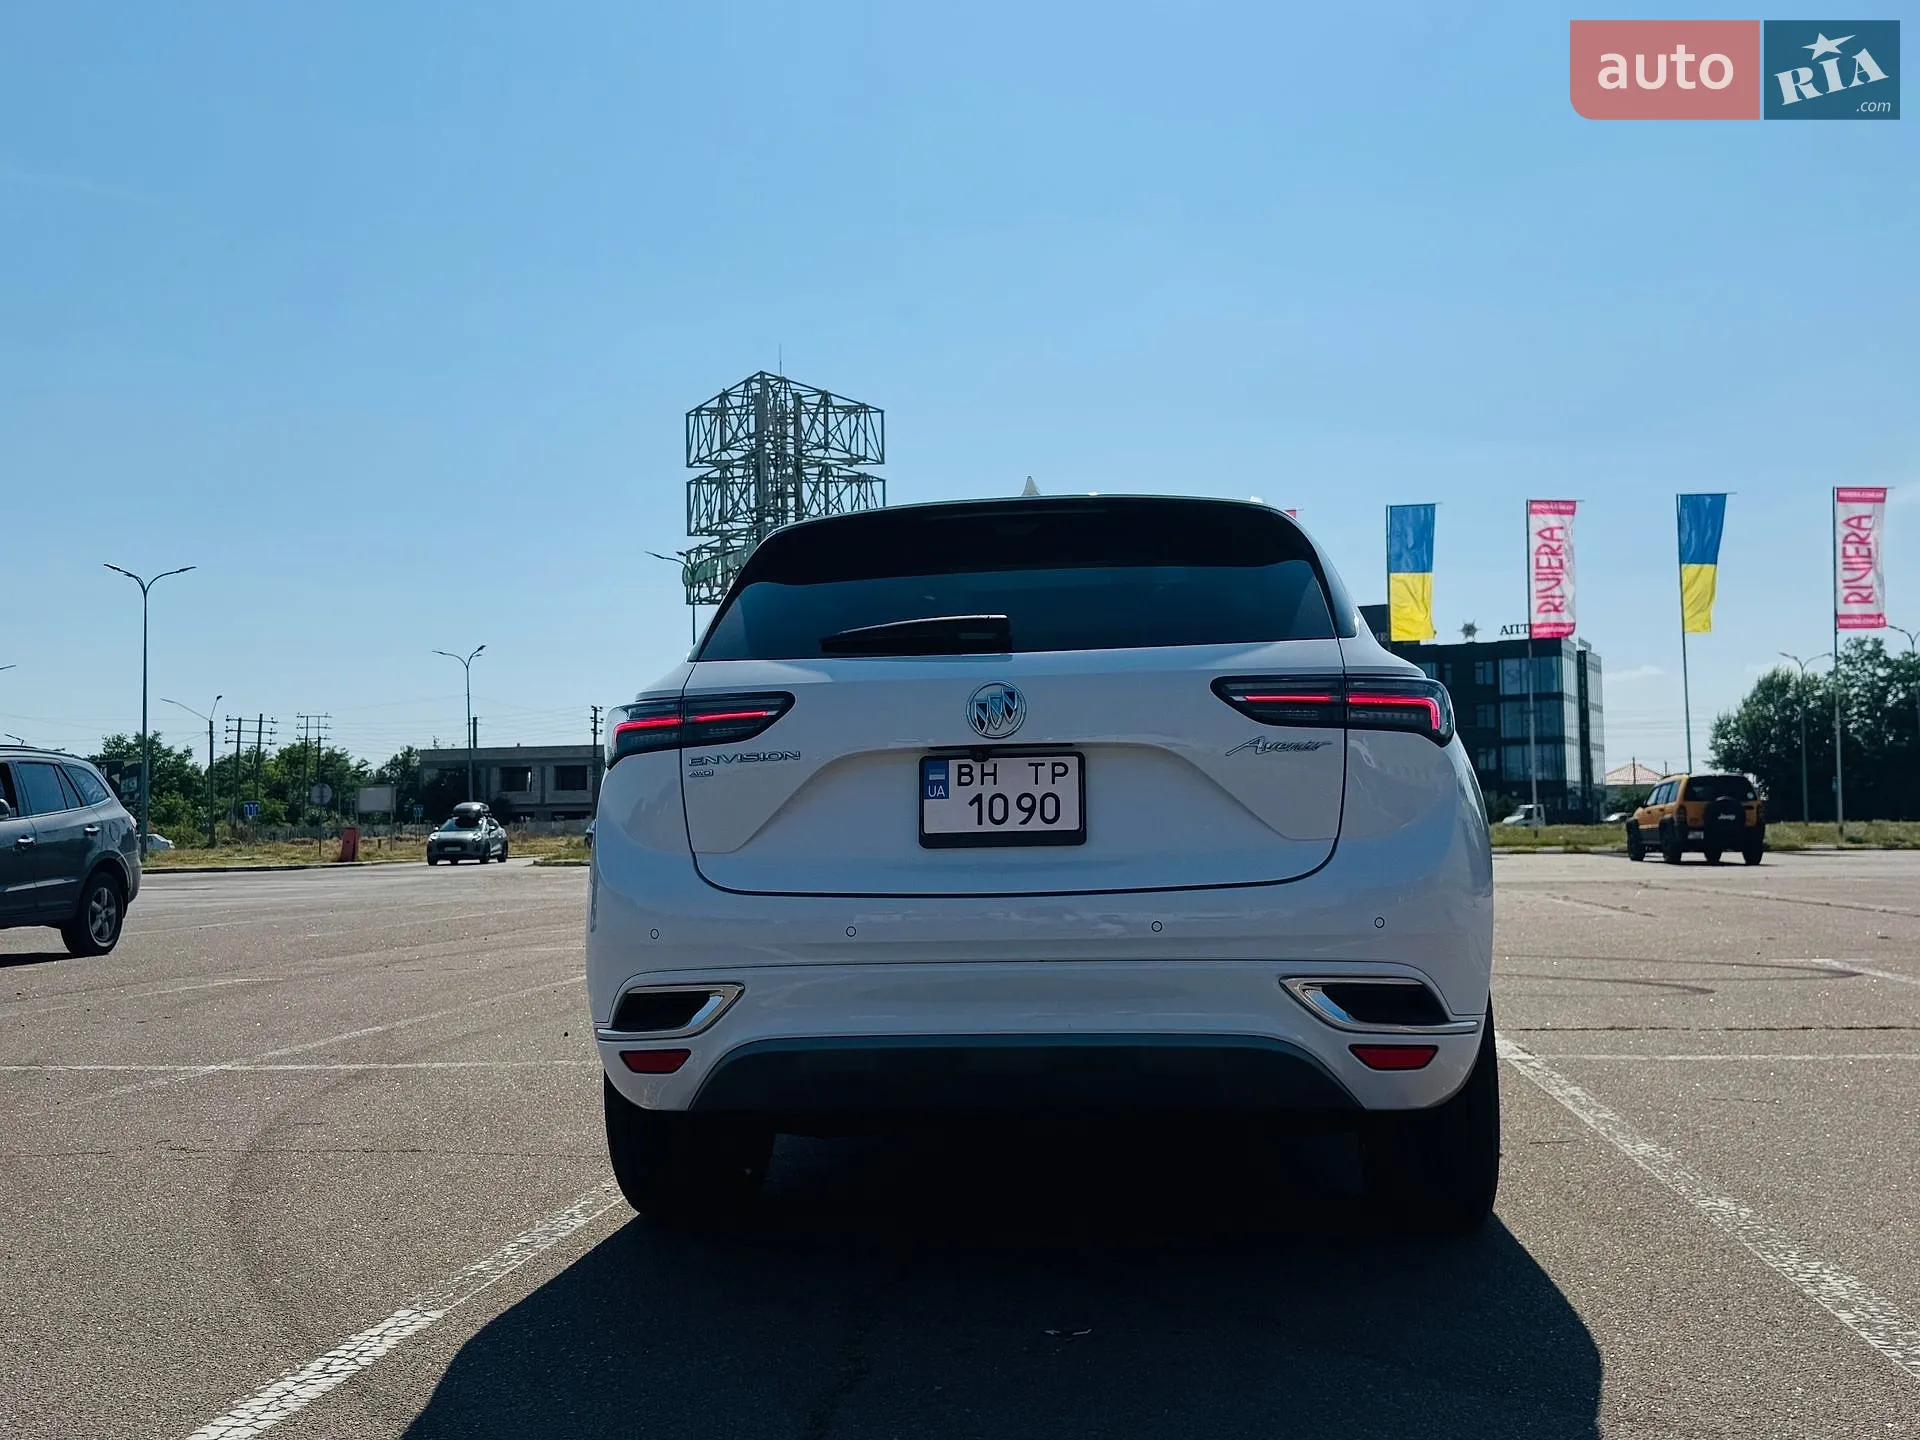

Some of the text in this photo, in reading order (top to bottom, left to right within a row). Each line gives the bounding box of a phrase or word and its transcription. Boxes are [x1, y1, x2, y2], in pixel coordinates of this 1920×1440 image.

[1535, 525, 1564, 613] RIVIERA
[1842, 514, 1874, 604] RIVIERA
[689, 751, 800, 766] ENVISION
[928, 785, 946, 798] UA
[968, 792, 1061, 826] 1090
